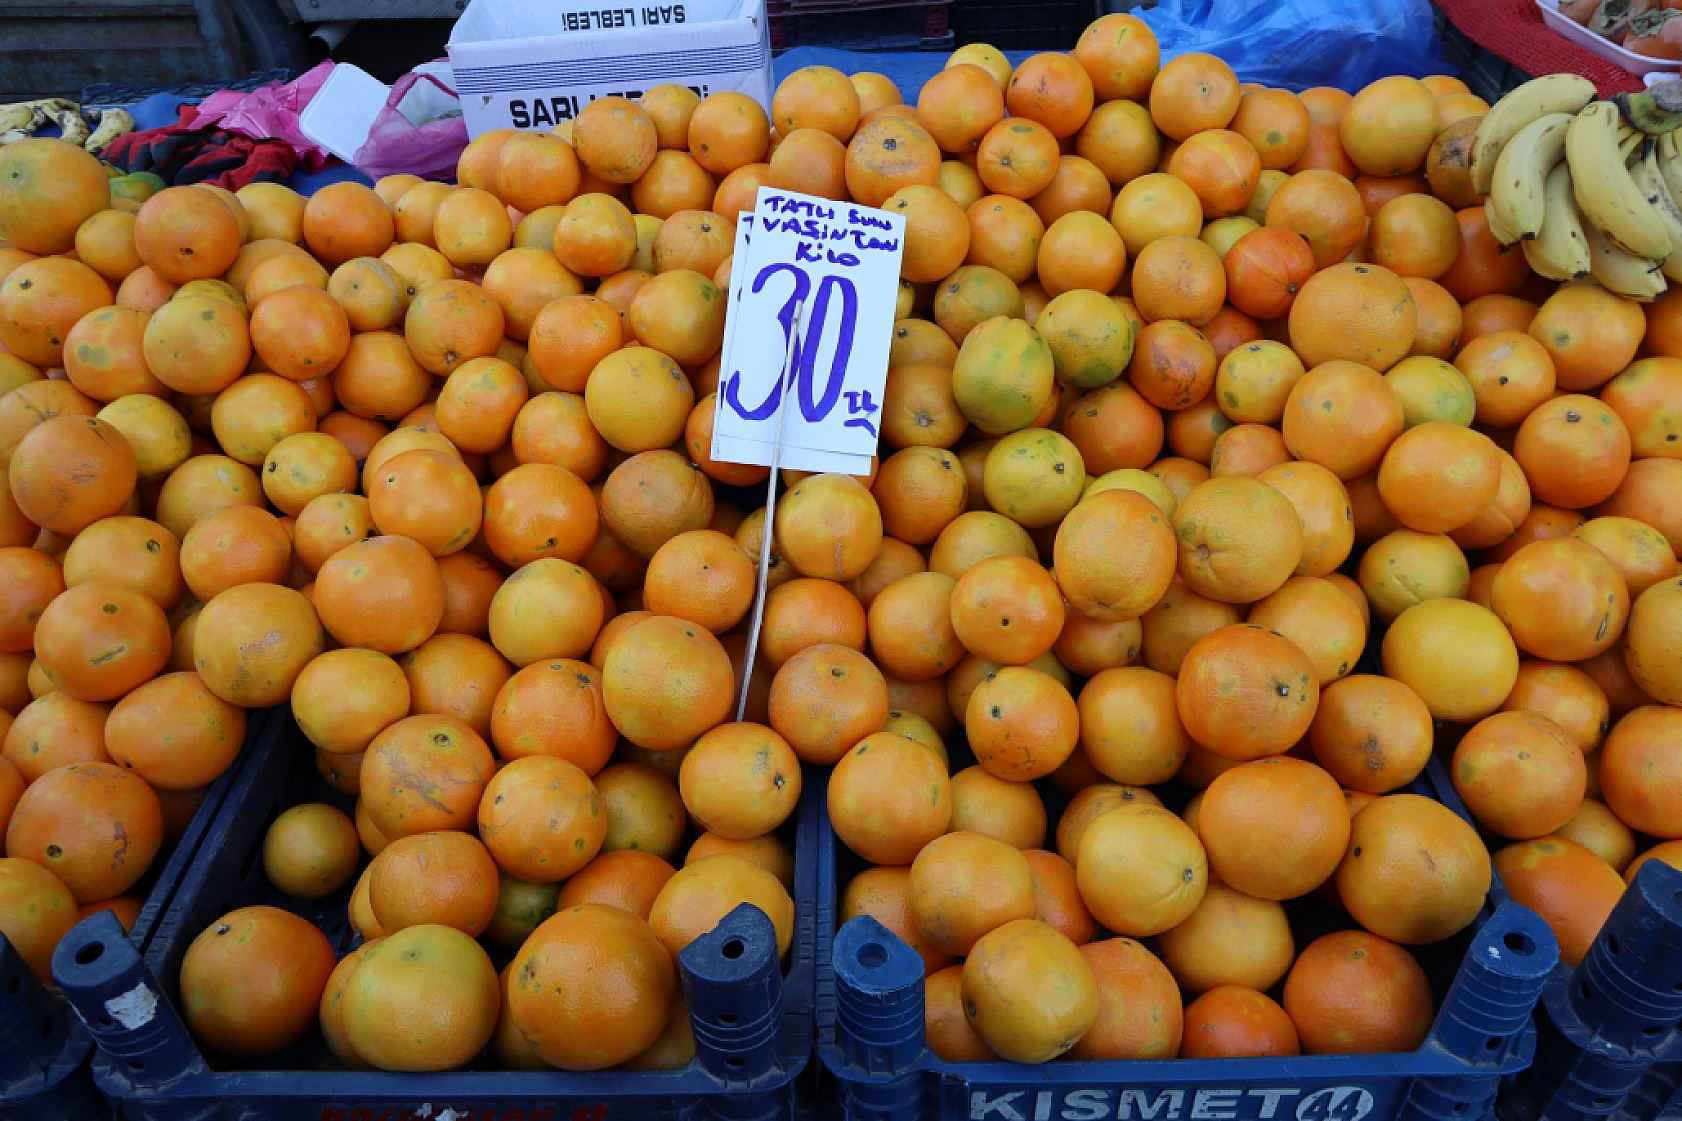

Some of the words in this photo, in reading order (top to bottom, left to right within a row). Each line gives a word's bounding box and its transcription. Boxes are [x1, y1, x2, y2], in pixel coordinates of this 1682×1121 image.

[642, 5, 686, 25] SARI
[725, 262, 858, 422] 30
[970, 1089, 1301, 1121] KISMET
